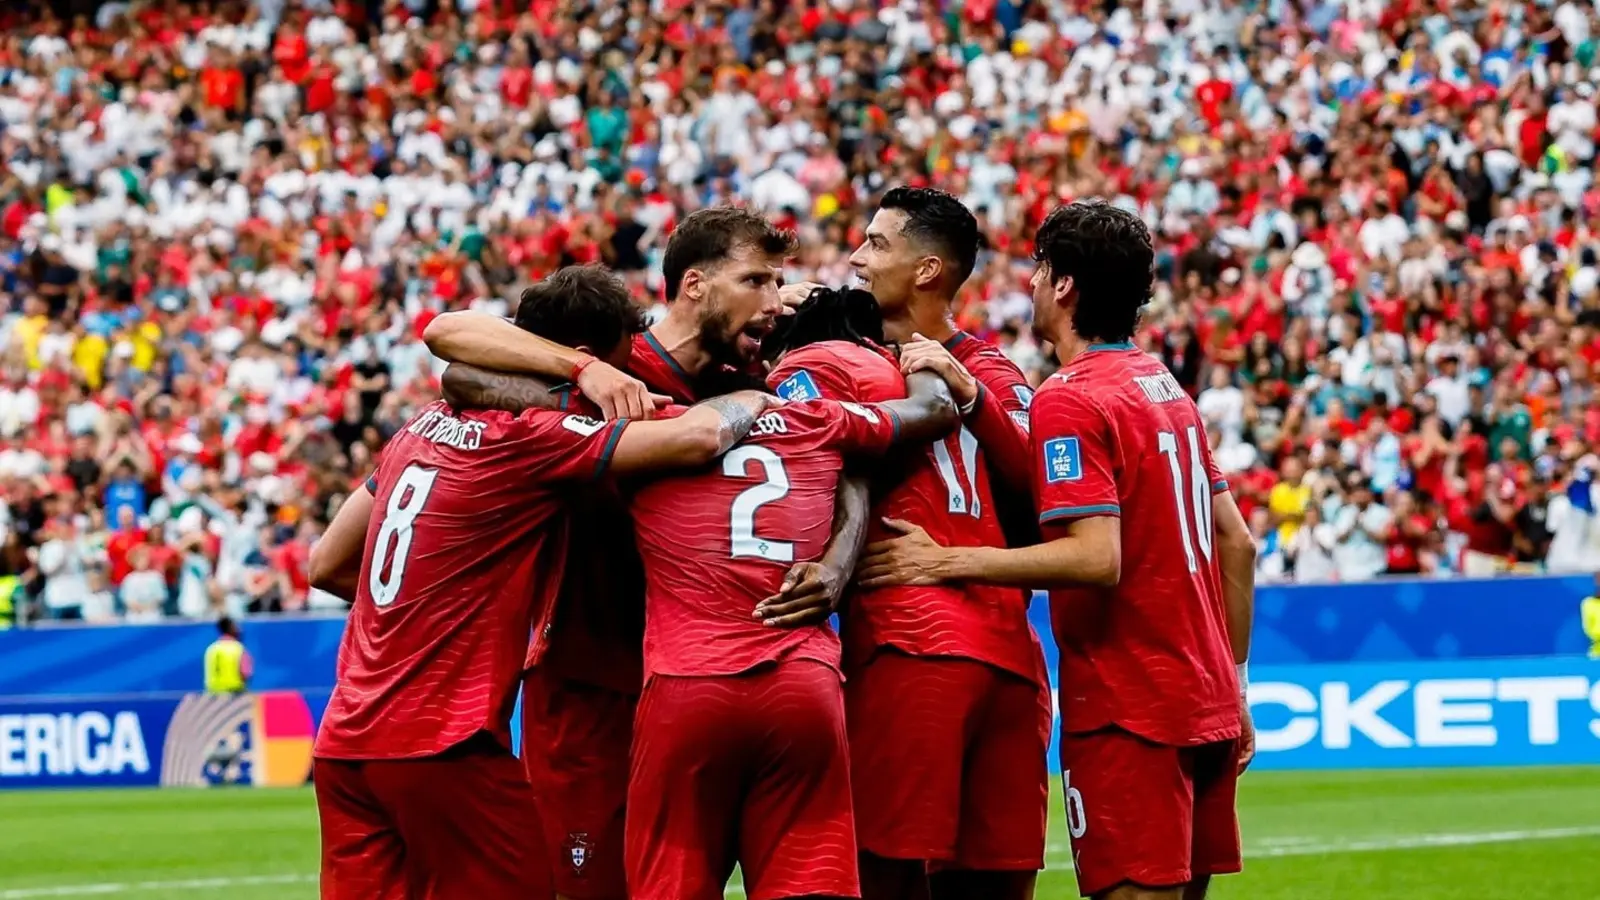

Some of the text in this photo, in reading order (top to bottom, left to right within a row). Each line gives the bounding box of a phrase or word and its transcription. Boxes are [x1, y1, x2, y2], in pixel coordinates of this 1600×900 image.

[370, 464, 439, 607] 8
[723, 445, 794, 562] 2
[1158, 425, 1212, 574] 16
[0, 711, 150, 776] ERICA
[1249, 675, 1600, 751] CKET
